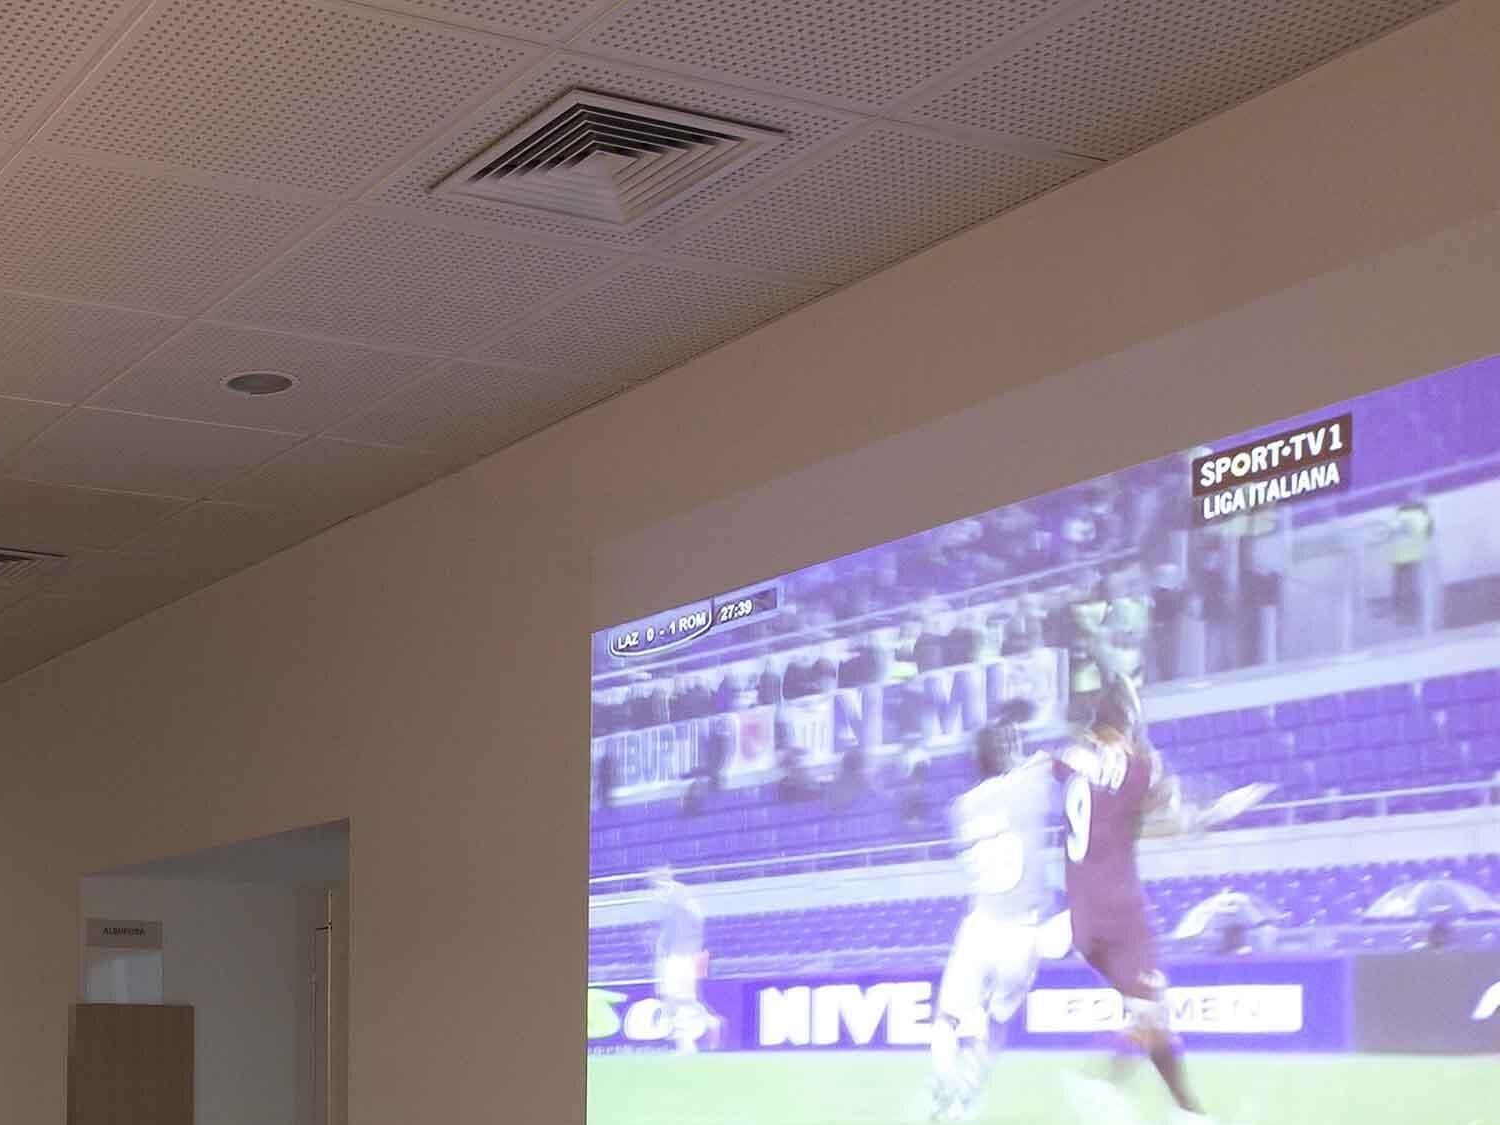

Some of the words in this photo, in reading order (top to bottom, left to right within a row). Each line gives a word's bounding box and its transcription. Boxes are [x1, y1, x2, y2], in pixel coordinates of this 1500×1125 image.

[1203, 488, 1245, 520] LIGA
[1249, 462, 1341, 507] ITALIANA
[617, 631, 639, 650] LAZ
[646, 628, 655, 642] 0
[668, 622, 676, 635] 1
[678, 612, 707, 632] ROM
[720, 599, 753, 622] 27:39
[758, 981, 936, 1047] NIVE
